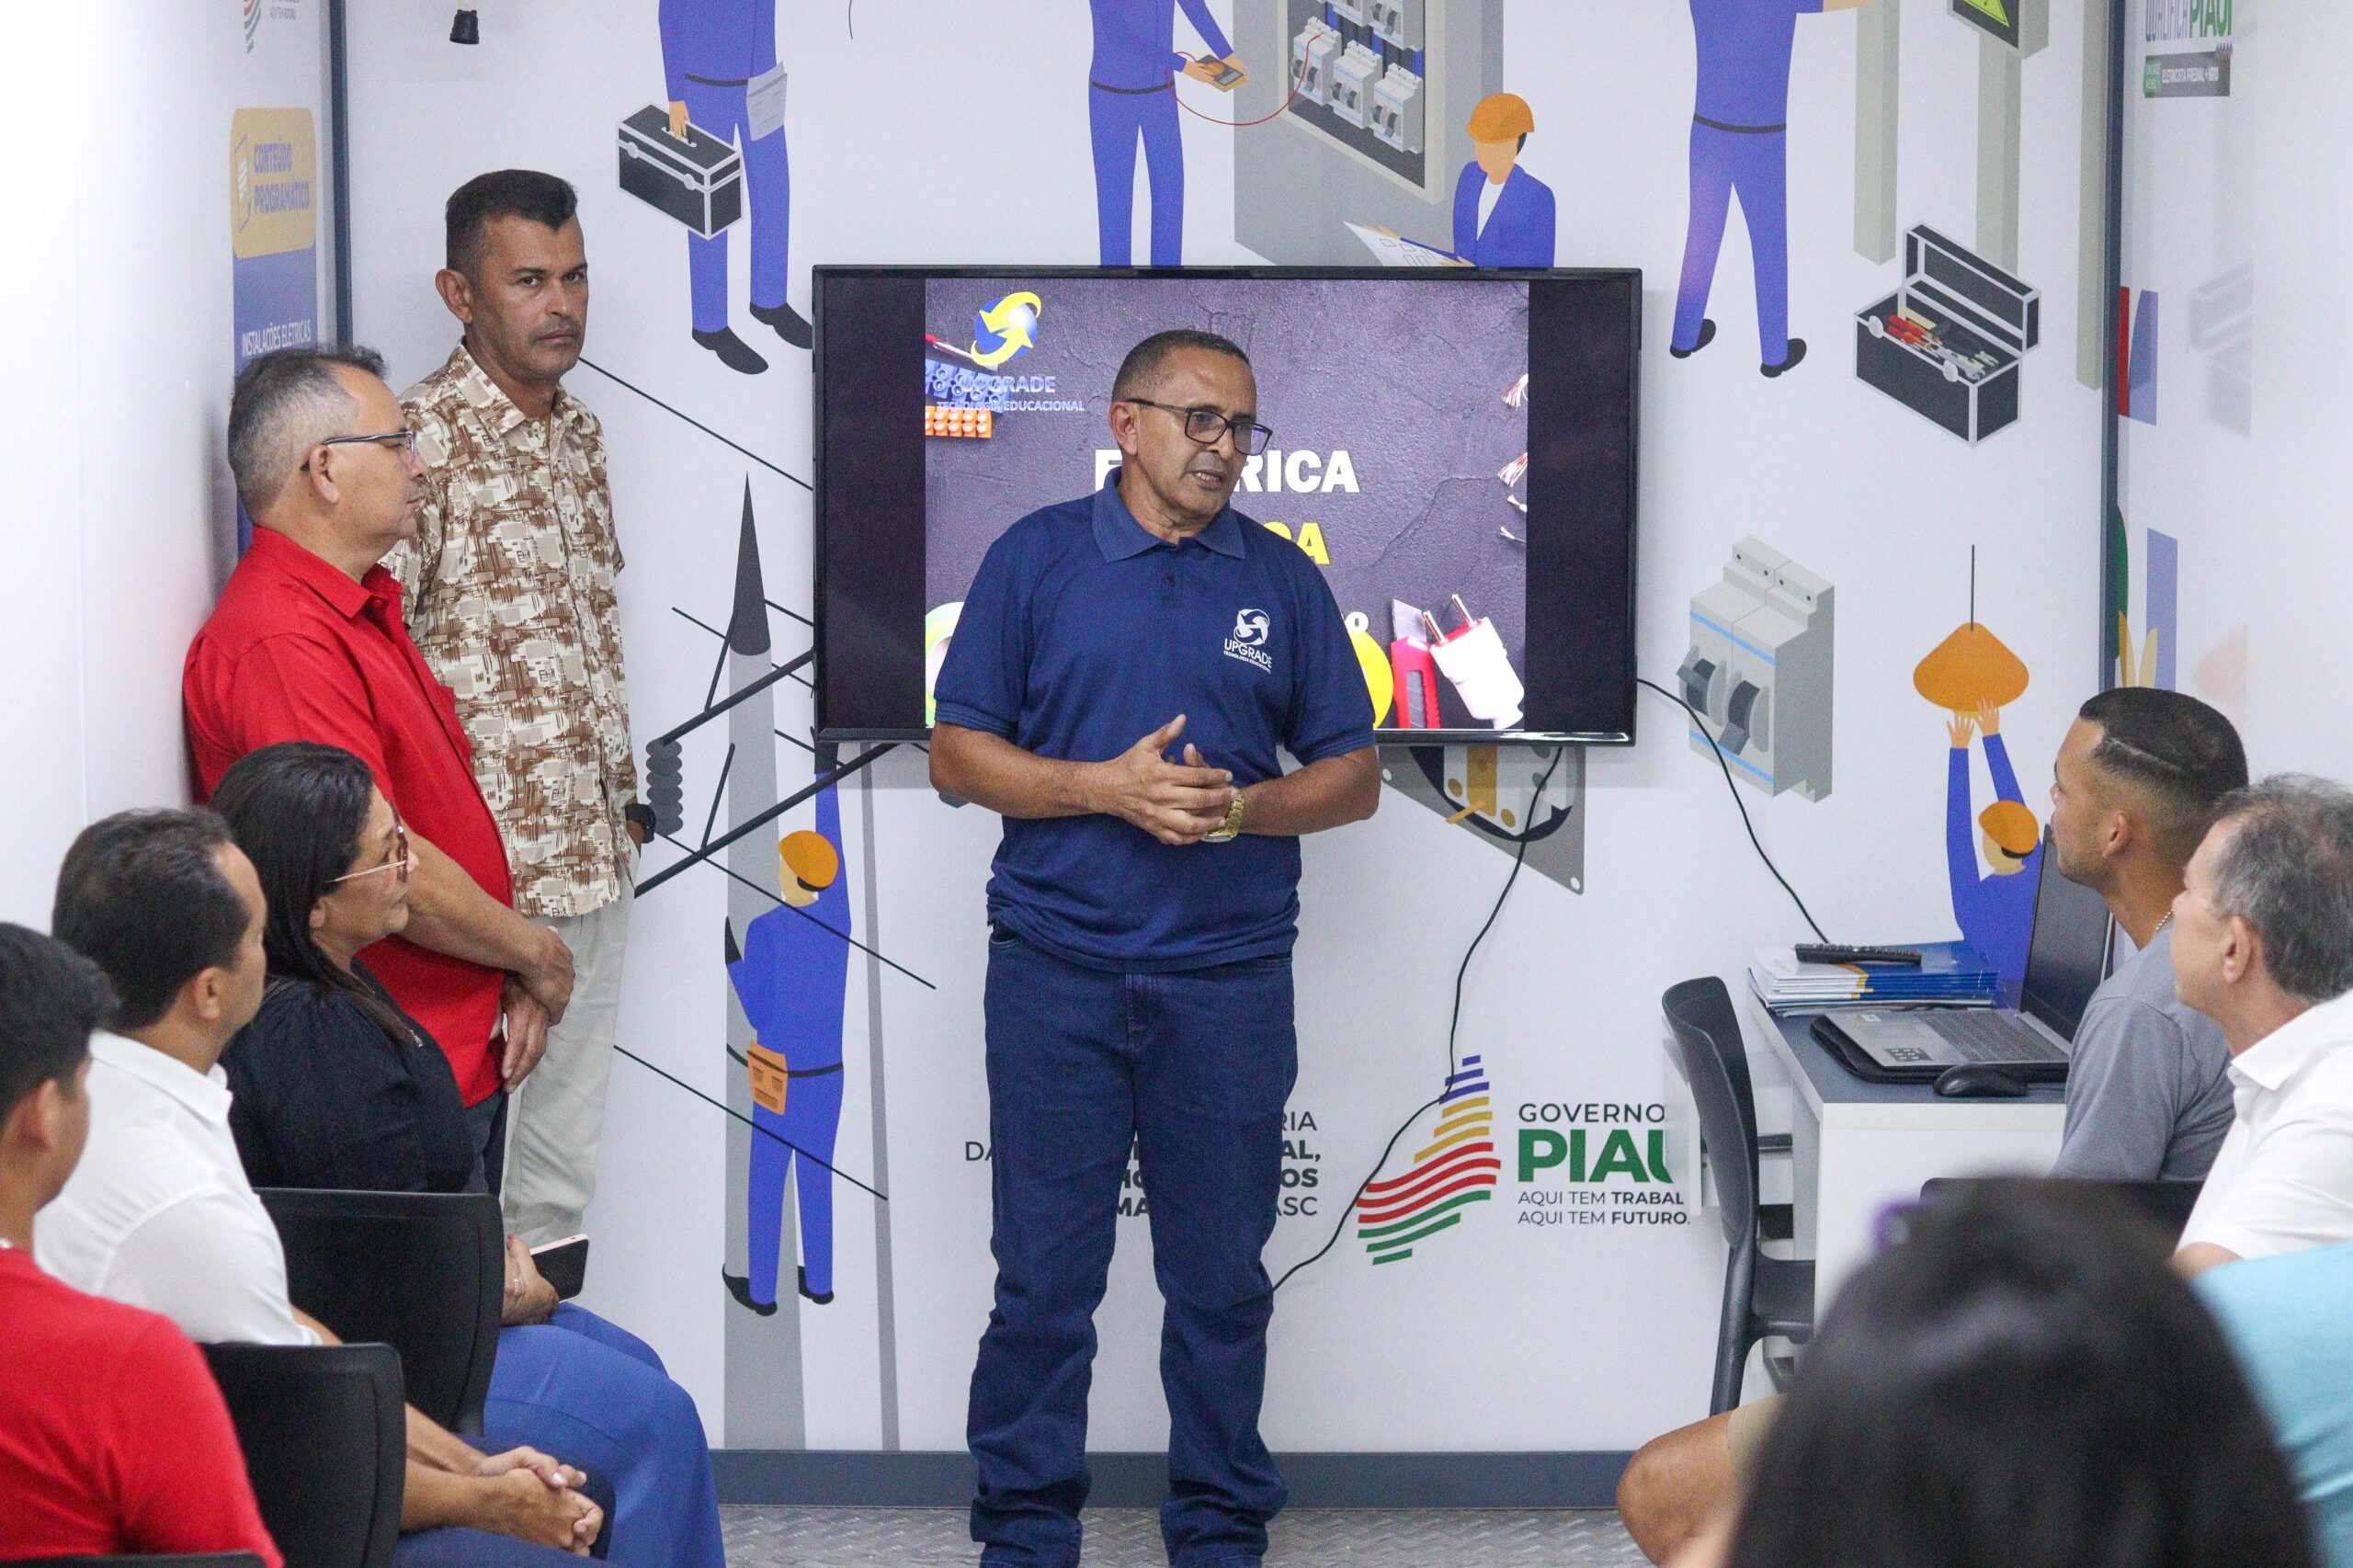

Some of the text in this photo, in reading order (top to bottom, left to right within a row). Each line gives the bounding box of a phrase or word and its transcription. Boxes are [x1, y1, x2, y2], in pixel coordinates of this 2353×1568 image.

[242, 318, 311, 358] INSTALAÇÕES ELÉTRICAS
[961, 375, 1056, 393] UPGRADE
[1004, 401, 1085, 412] EDUCACIONAL
[1224, 638, 1272, 668] UPGRADE
[1518, 1103, 1665, 1123] GOVERNO
[1518, 1191, 1684, 1207] AQUI TEM TRABAL
[1518, 1211, 1691, 1226] AQUI TEM FUTURO.
